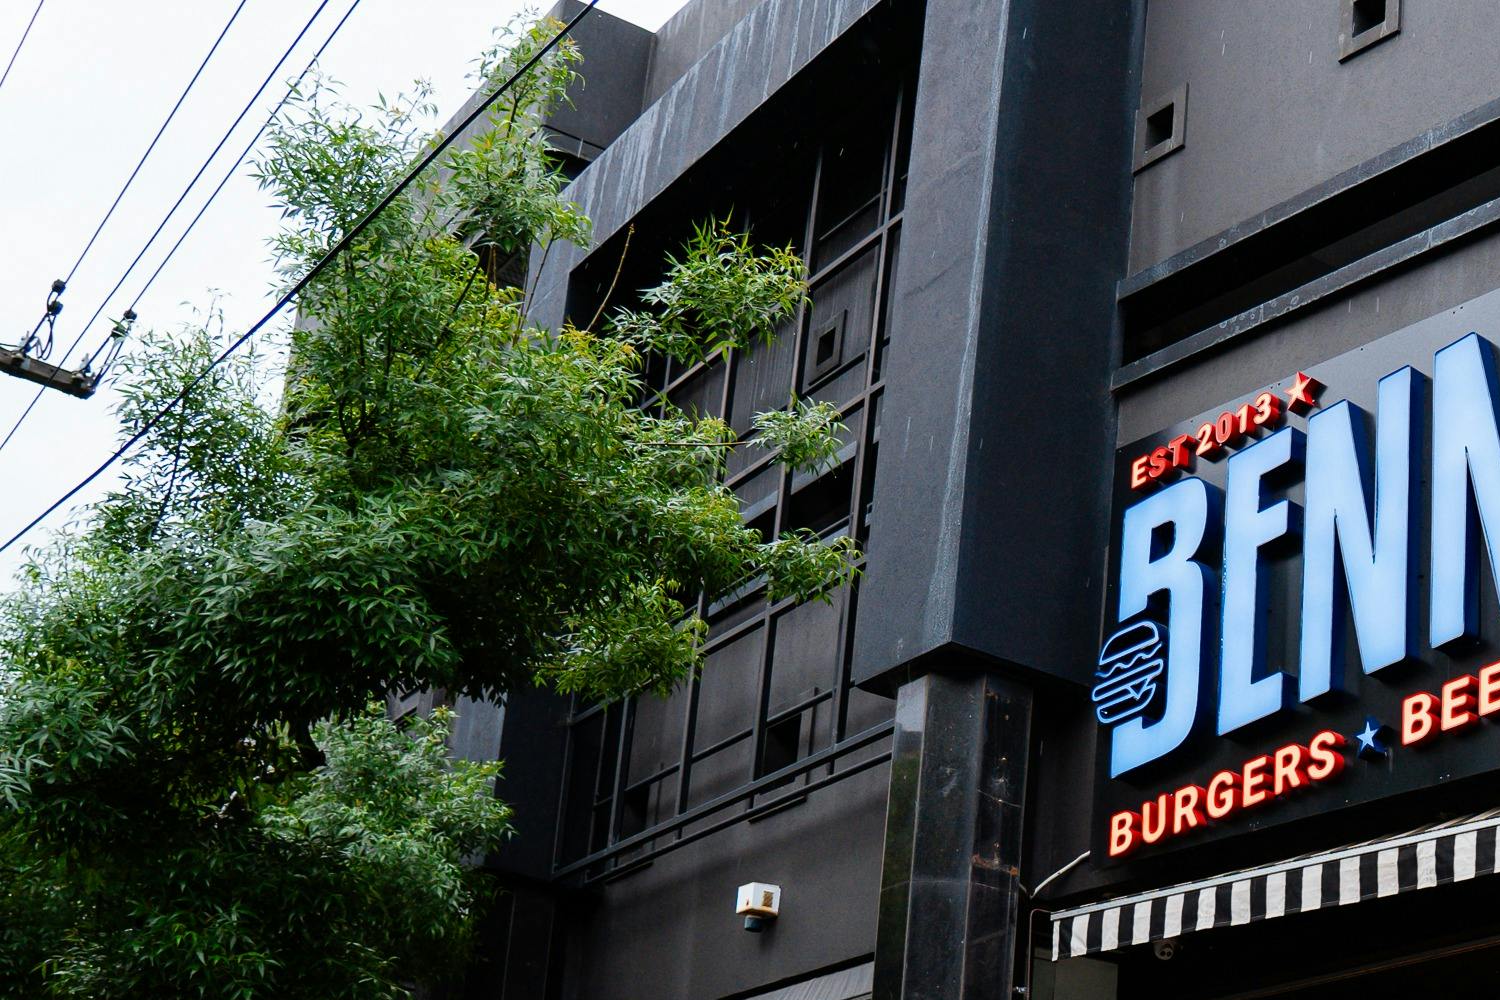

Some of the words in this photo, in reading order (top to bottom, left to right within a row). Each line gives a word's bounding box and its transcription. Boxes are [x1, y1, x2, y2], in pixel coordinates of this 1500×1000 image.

[1131, 437, 1193, 490] EST
[1195, 392, 1280, 457] 2013
[1108, 729, 1345, 858] BURGERS
